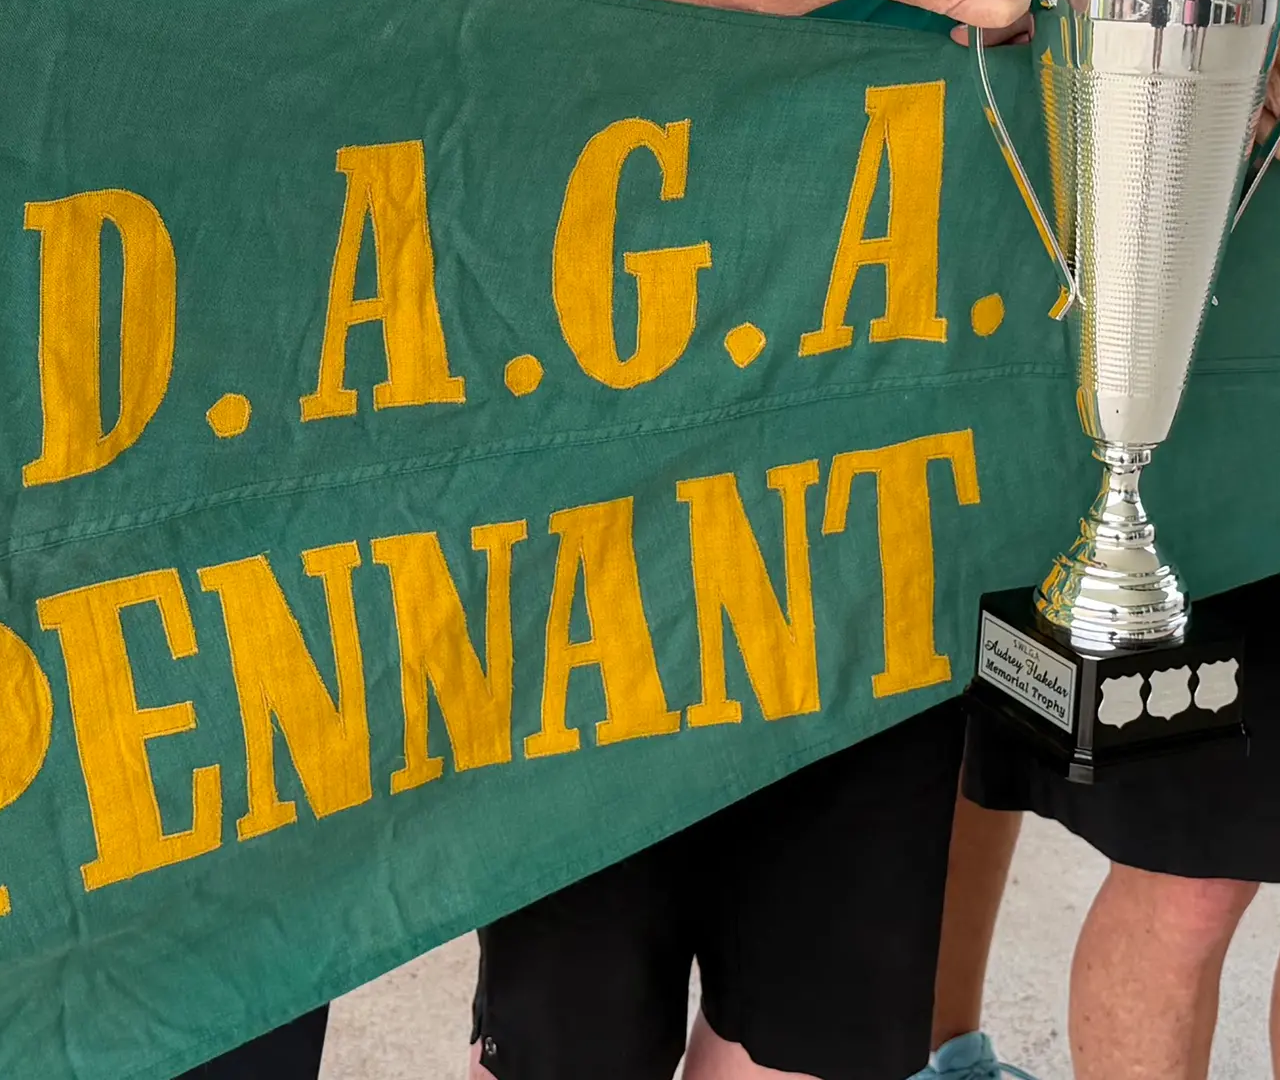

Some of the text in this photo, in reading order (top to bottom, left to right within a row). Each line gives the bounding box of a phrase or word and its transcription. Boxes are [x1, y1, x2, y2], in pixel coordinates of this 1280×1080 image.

[984, 639, 1024, 674] Audrey
[985, 658, 1066, 718] Memorial Trophy
